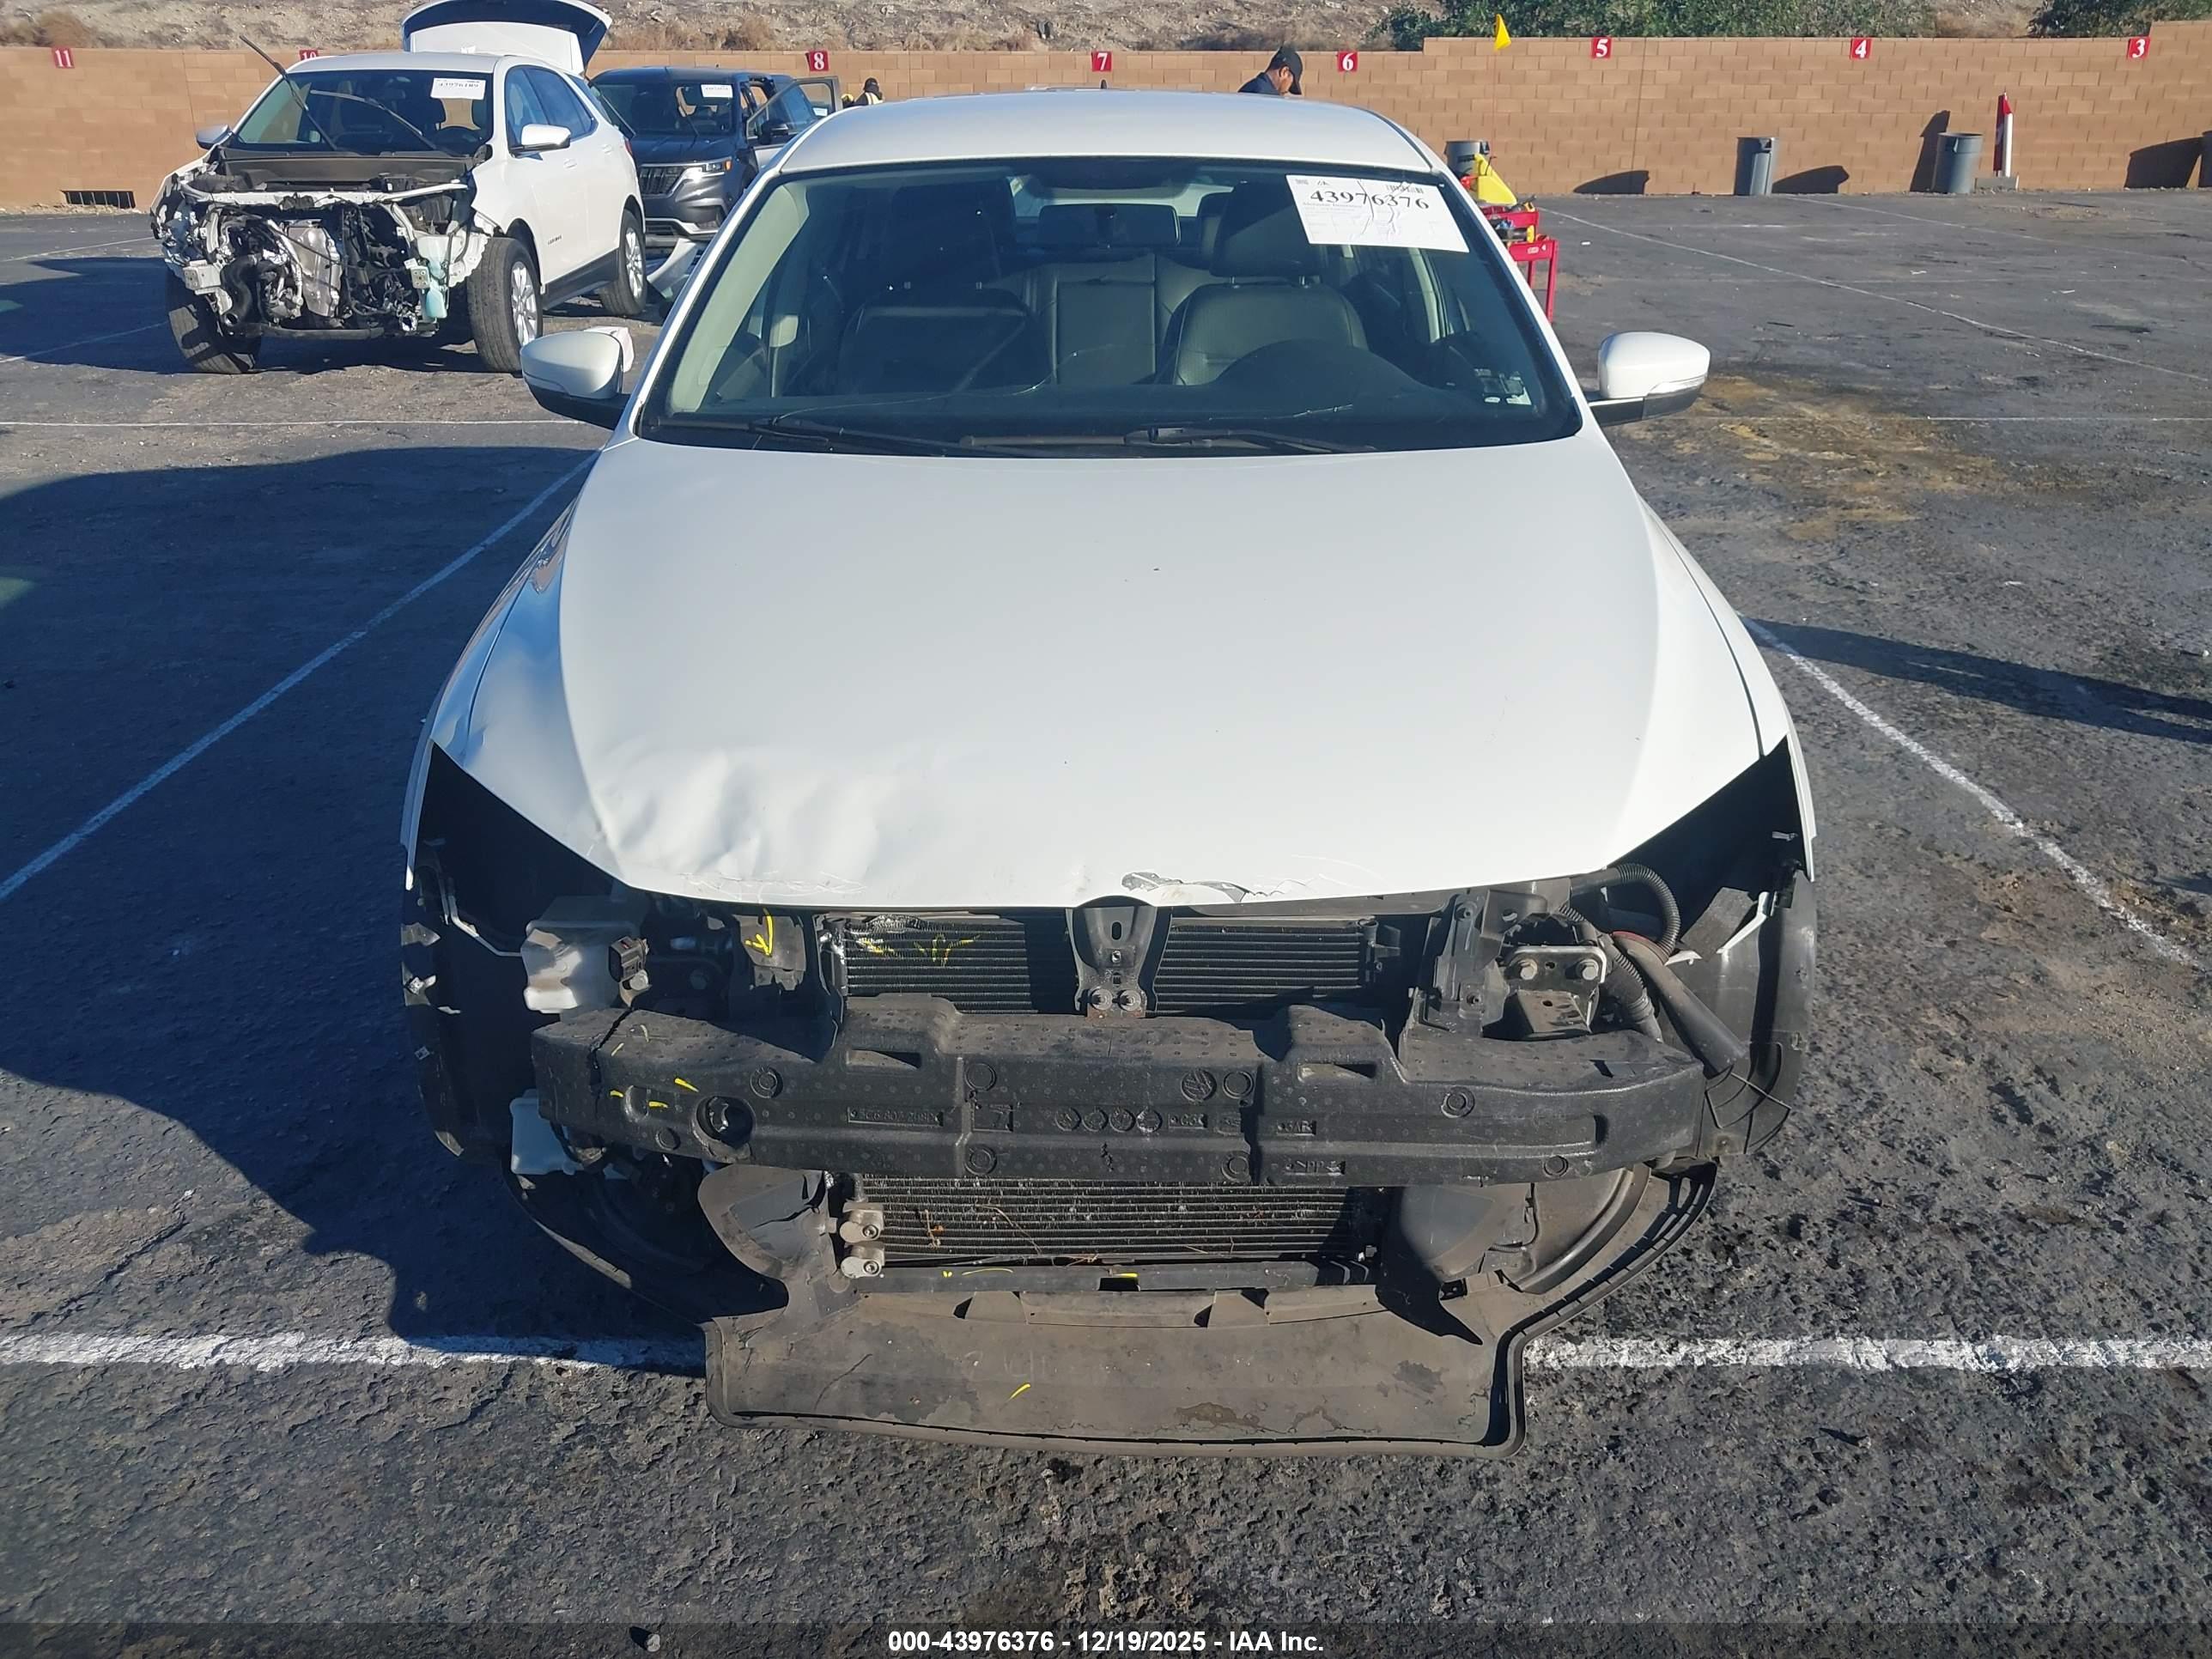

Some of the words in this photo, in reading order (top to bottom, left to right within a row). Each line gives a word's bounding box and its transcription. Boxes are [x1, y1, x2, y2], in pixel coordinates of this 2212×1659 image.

[1595, 39, 1608, 58] 5
[1855, 40, 1867, 58] 4
[2131, 39, 2146, 58] 3
[55, 49, 74, 68] 11
[813, 52, 825, 70] 8
[1097, 52, 1109, 70] 7
[1341, 52, 1354, 70] 6
[1310, 190, 1430, 210] 43976376
